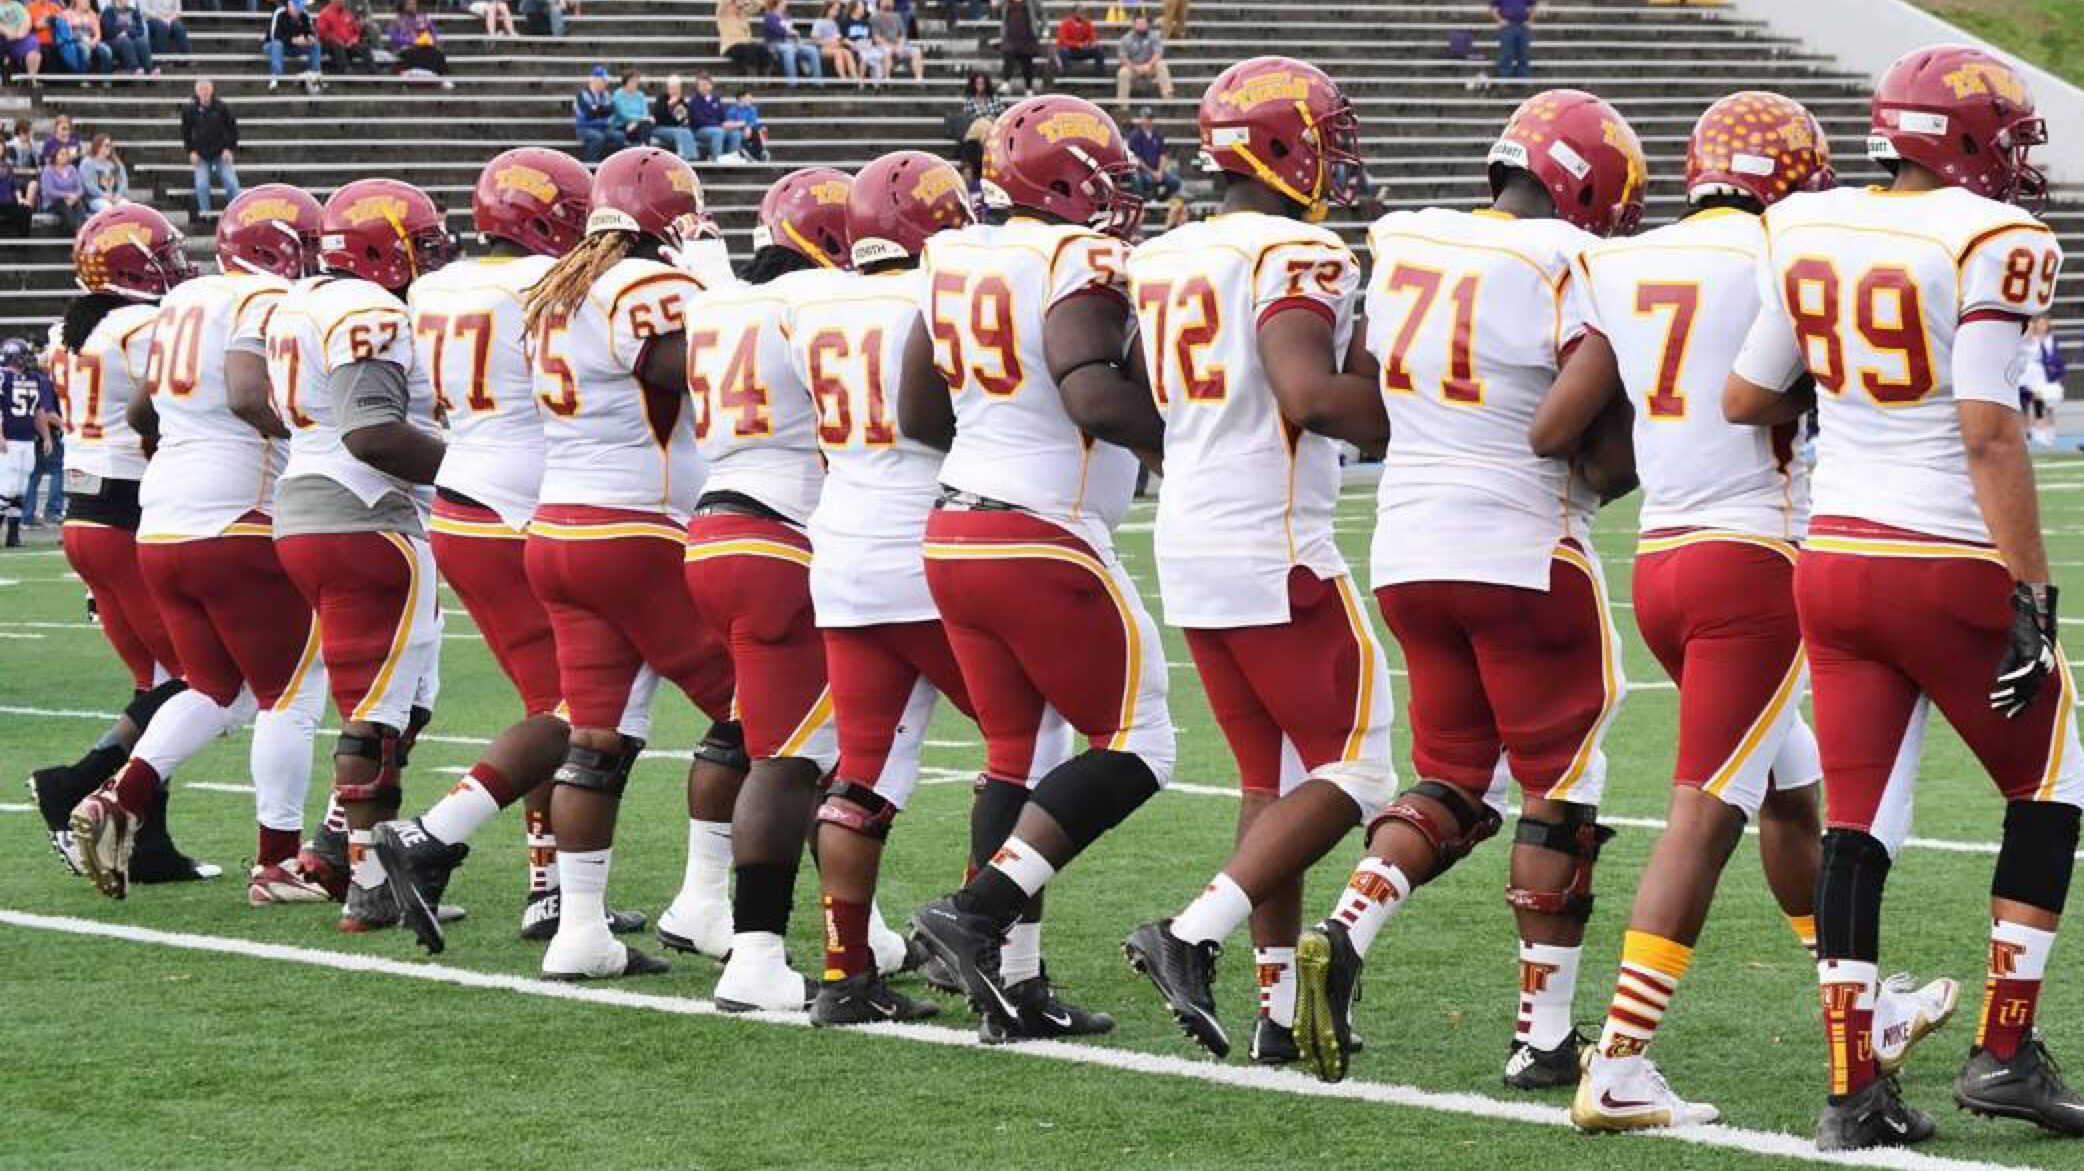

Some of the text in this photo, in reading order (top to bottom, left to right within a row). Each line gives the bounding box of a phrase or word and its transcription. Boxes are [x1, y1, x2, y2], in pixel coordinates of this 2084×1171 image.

[629, 292, 686, 341] 65
[1086, 247, 1130, 288] 5
[1286, 259, 1343, 297] 72
[2001, 246, 2059, 306] 89
[350, 318, 399, 363] 67
[415, 310, 496, 414] 77
[688, 324, 770, 441] 54
[931, 269, 1024, 399] 59
[1137, 274, 1229, 406] 72
[1384, 263, 1482, 405] 71
[1634, 279, 1699, 419] 7
[1784, 257, 1934, 406] 89
[11, 386, 39, 418] 57
[808, 328, 896, 445] 61
[1882, 1020, 1910, 1049] NIKE
